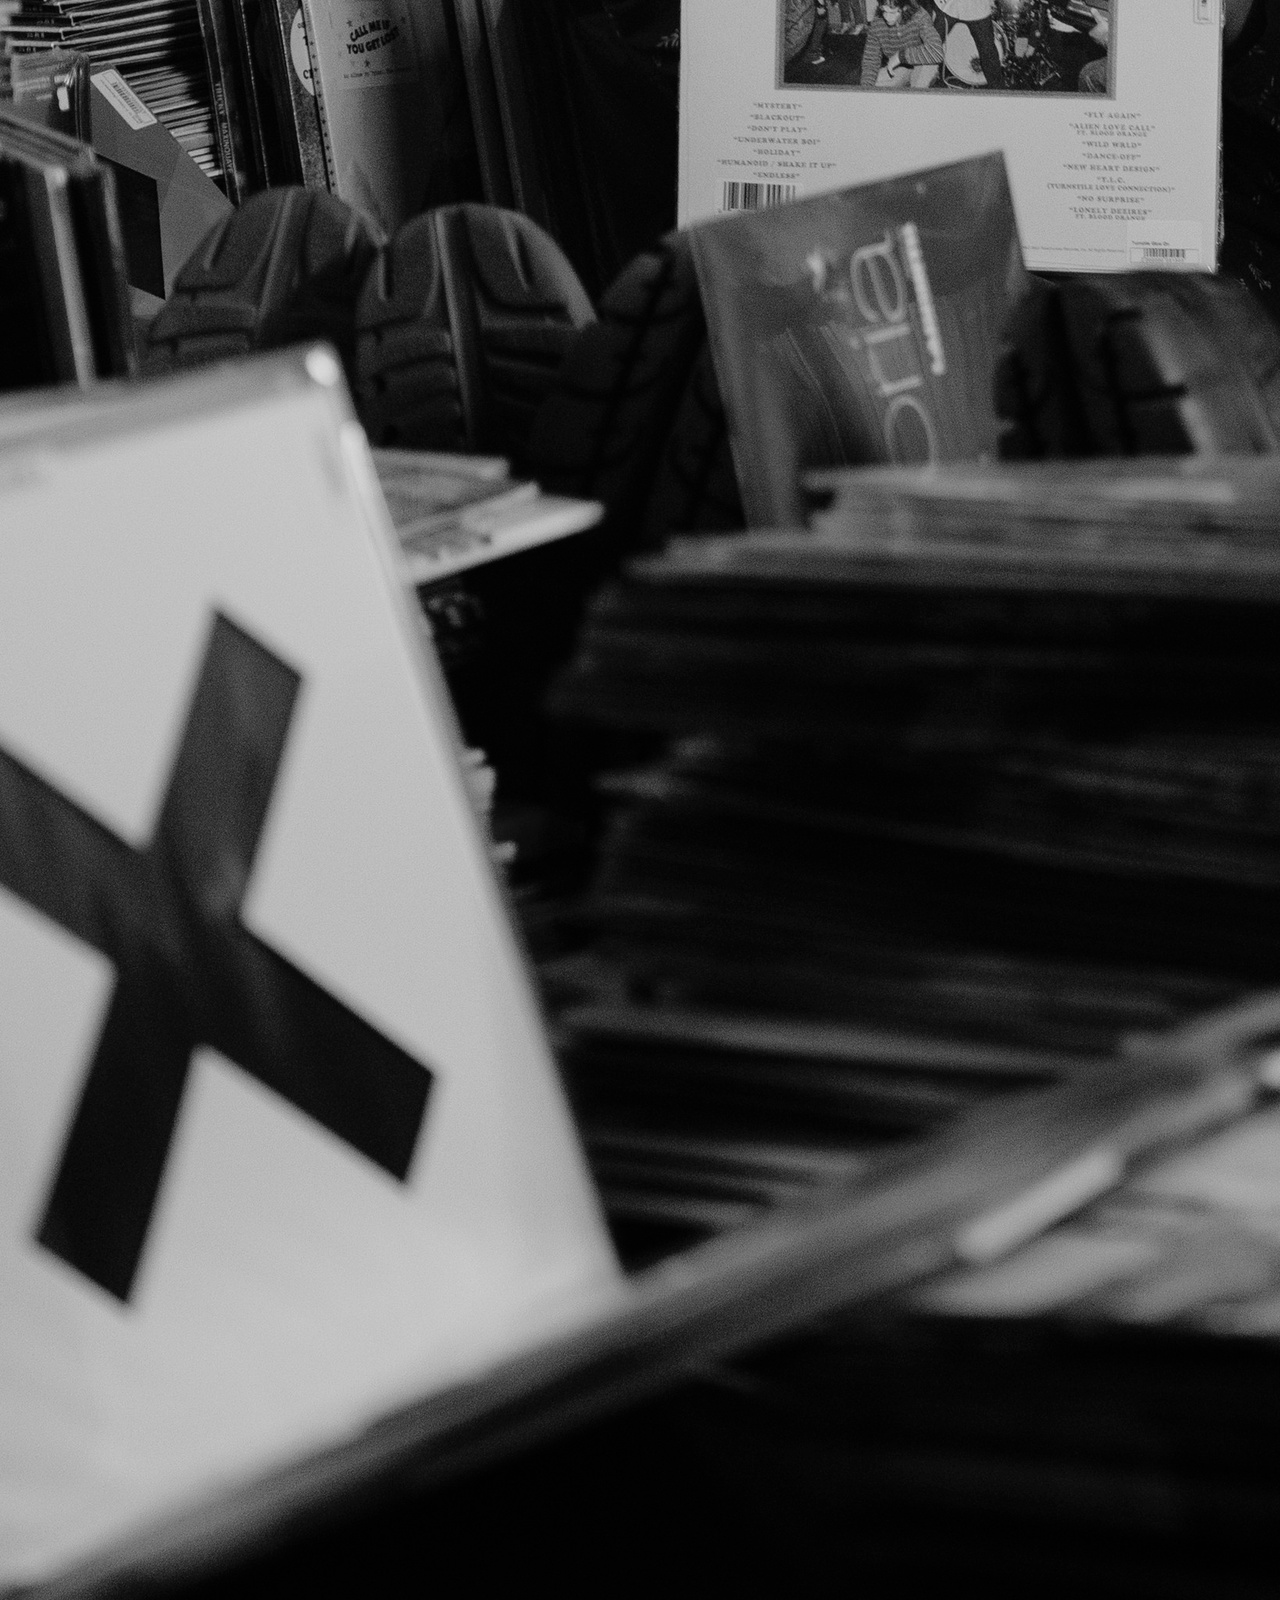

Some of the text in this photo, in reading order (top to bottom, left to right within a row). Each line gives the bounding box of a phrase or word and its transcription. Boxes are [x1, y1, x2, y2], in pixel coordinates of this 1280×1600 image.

[346, 25, 401, 55] YOU GET LOST
[350, 24, 369, 43] CALL
[368, 19, 382, 33] ME
[214, 82, 235, 174] TRICKY MAXINQUAYE
